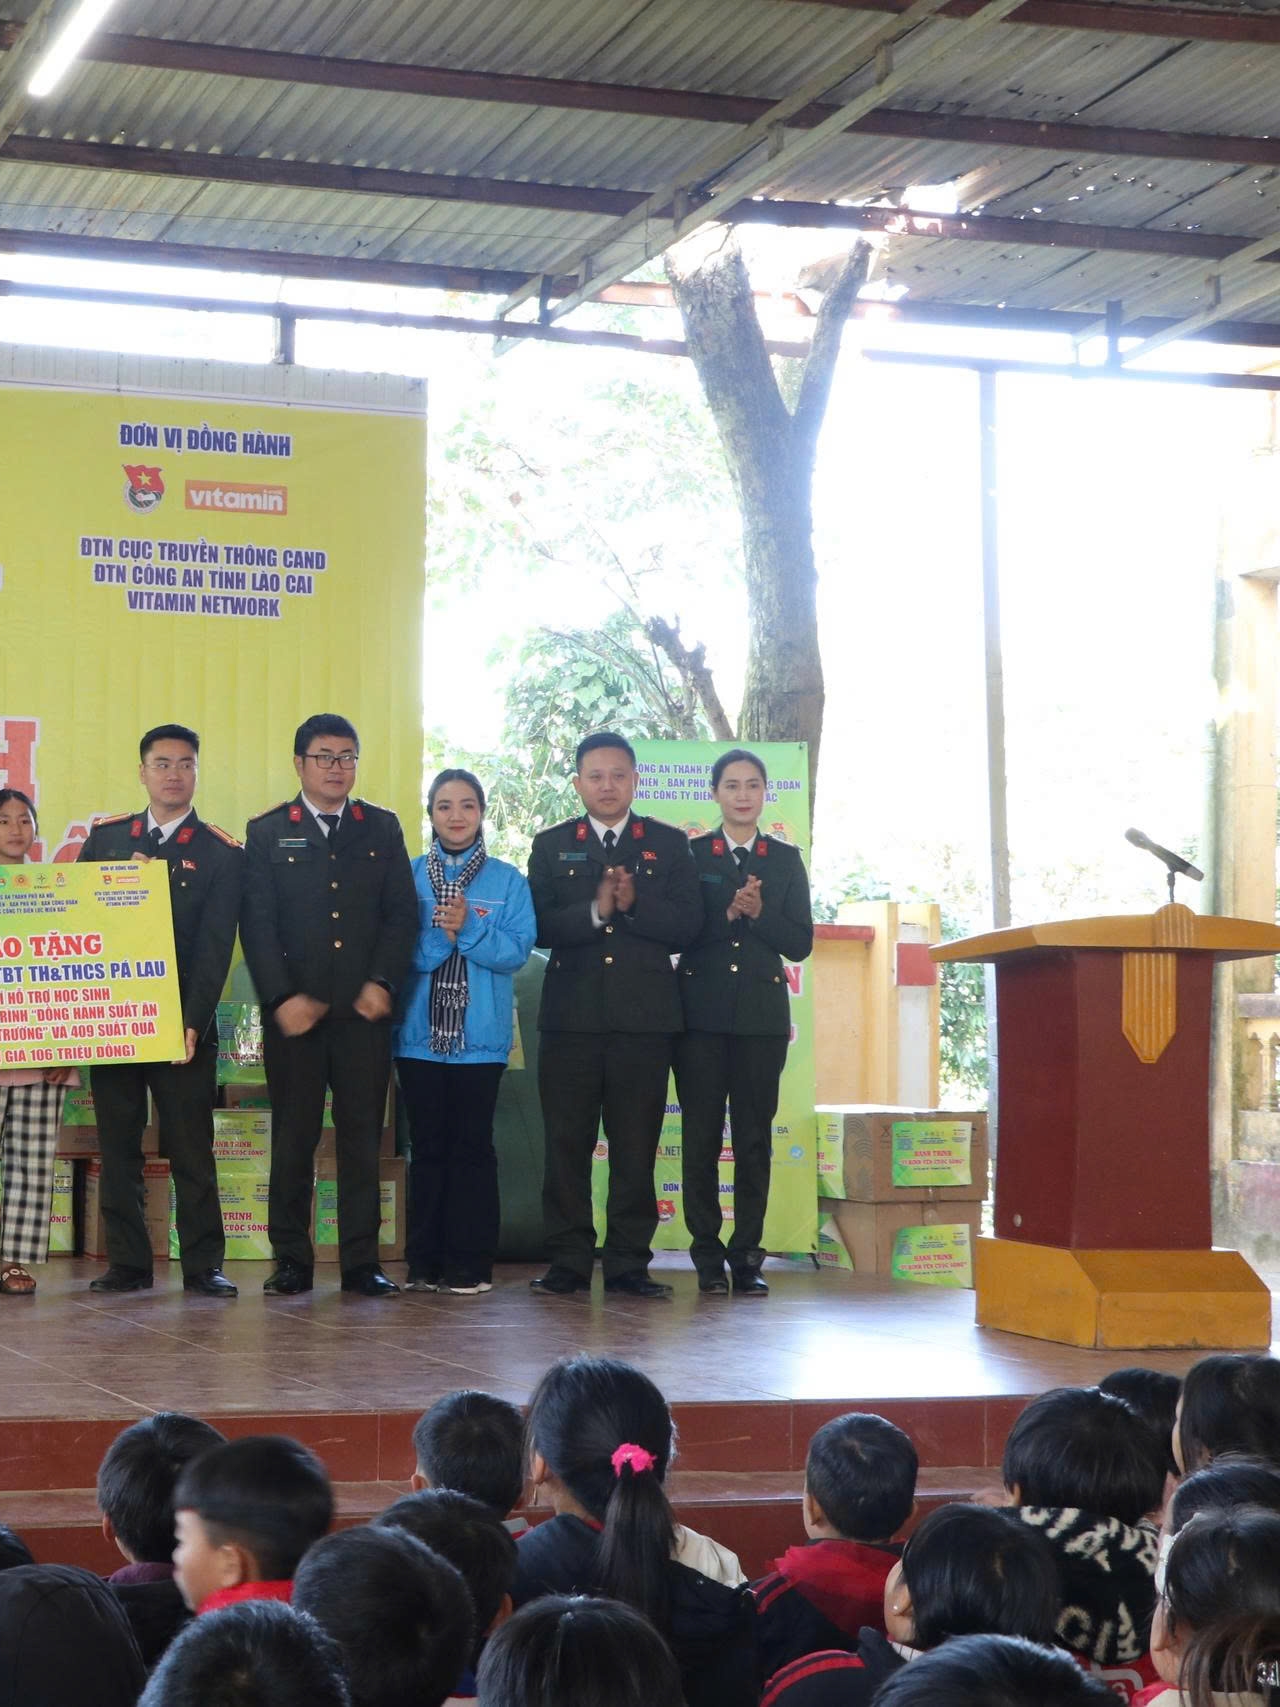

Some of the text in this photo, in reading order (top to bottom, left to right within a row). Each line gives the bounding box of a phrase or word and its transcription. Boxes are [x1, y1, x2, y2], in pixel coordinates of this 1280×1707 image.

[120, 423, 291, 456] ĐƠN VỊ ĐỒNG HÀNH
[190, 488, 283, 511] vitamin
[81, 537, 325, 569] ĐTN CỤC TRUYỀN THÔNG CAND
[94, 563, 312, 593] ĐTN CÔNG AN TỈNH LÀO CAI
[128, 591, 279, 616] VITAMIN NETWORK
[29, 934, 102, 960] TẶNG
[28, 963, 104, 981] TH&THCS
[111, 962, 131, 977] PÁ
[136, 961, 165, 977] LAU
[72, 1025, 94, 1037] 409
